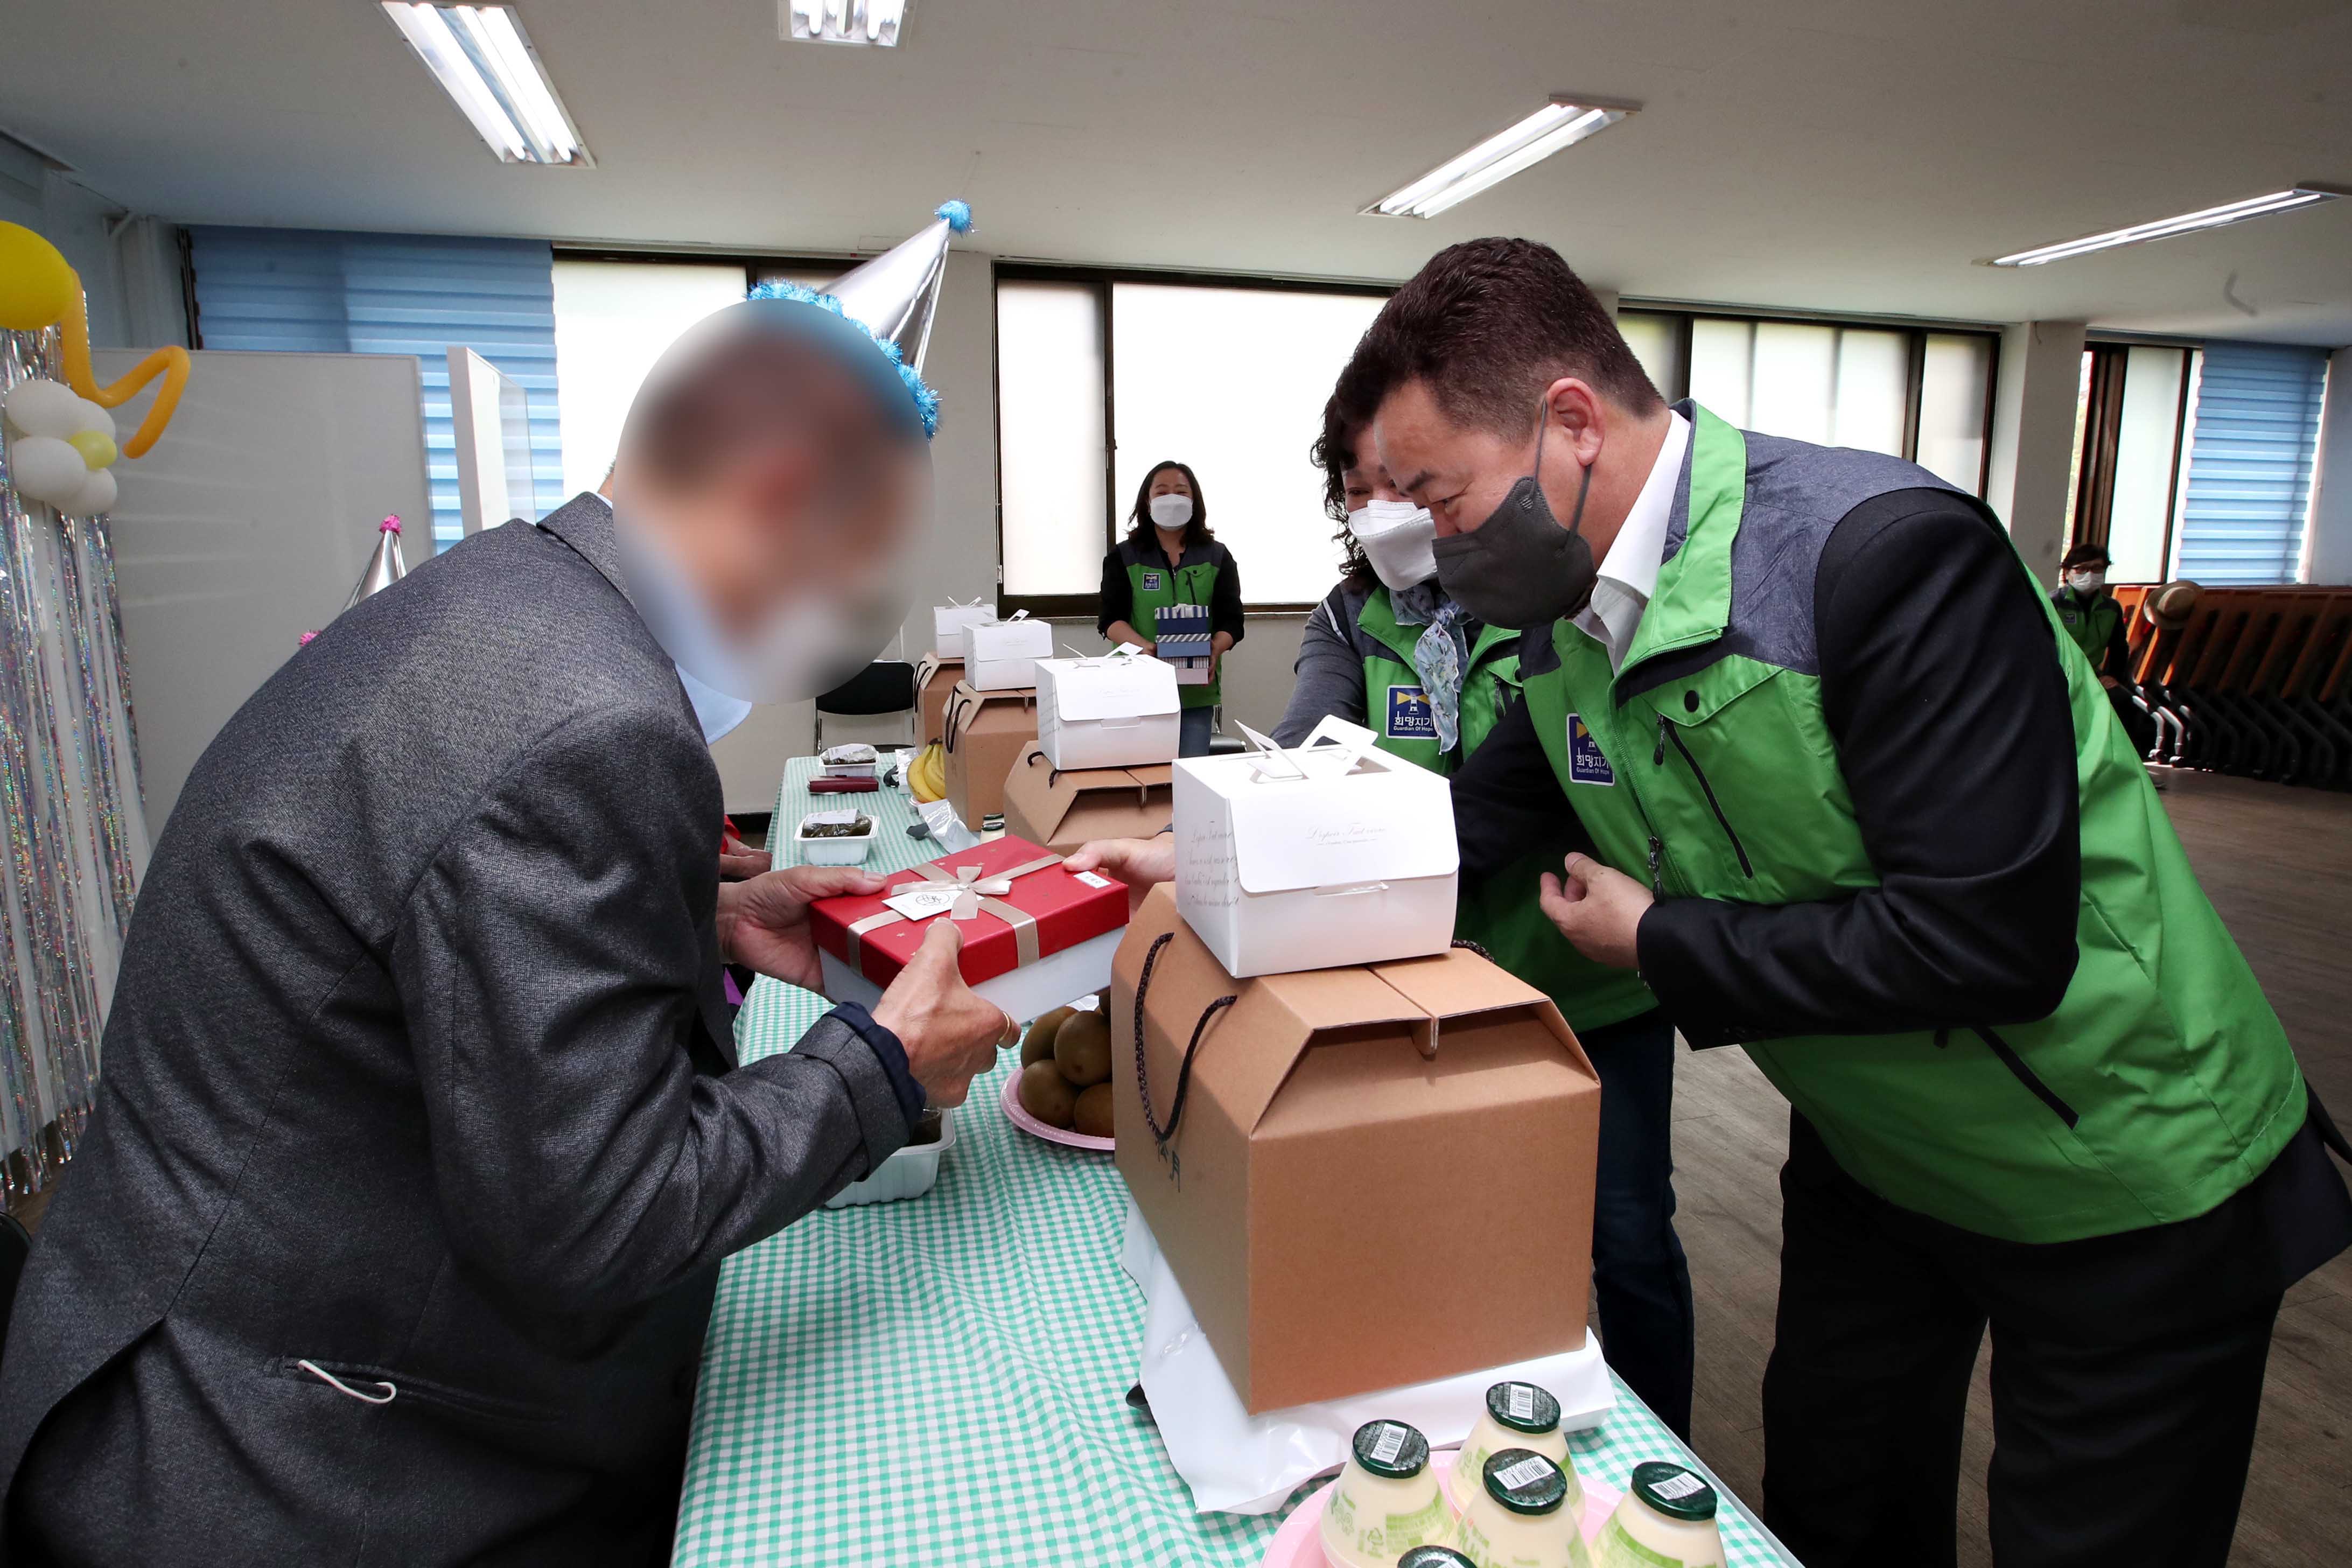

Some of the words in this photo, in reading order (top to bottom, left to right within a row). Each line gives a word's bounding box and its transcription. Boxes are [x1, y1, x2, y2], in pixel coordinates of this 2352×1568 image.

[1394, 711, 1432, 727] 희망지기
[1576, 746, 1609, 769] 희망지기
[1576, 766, 1594, 774] Guardian
